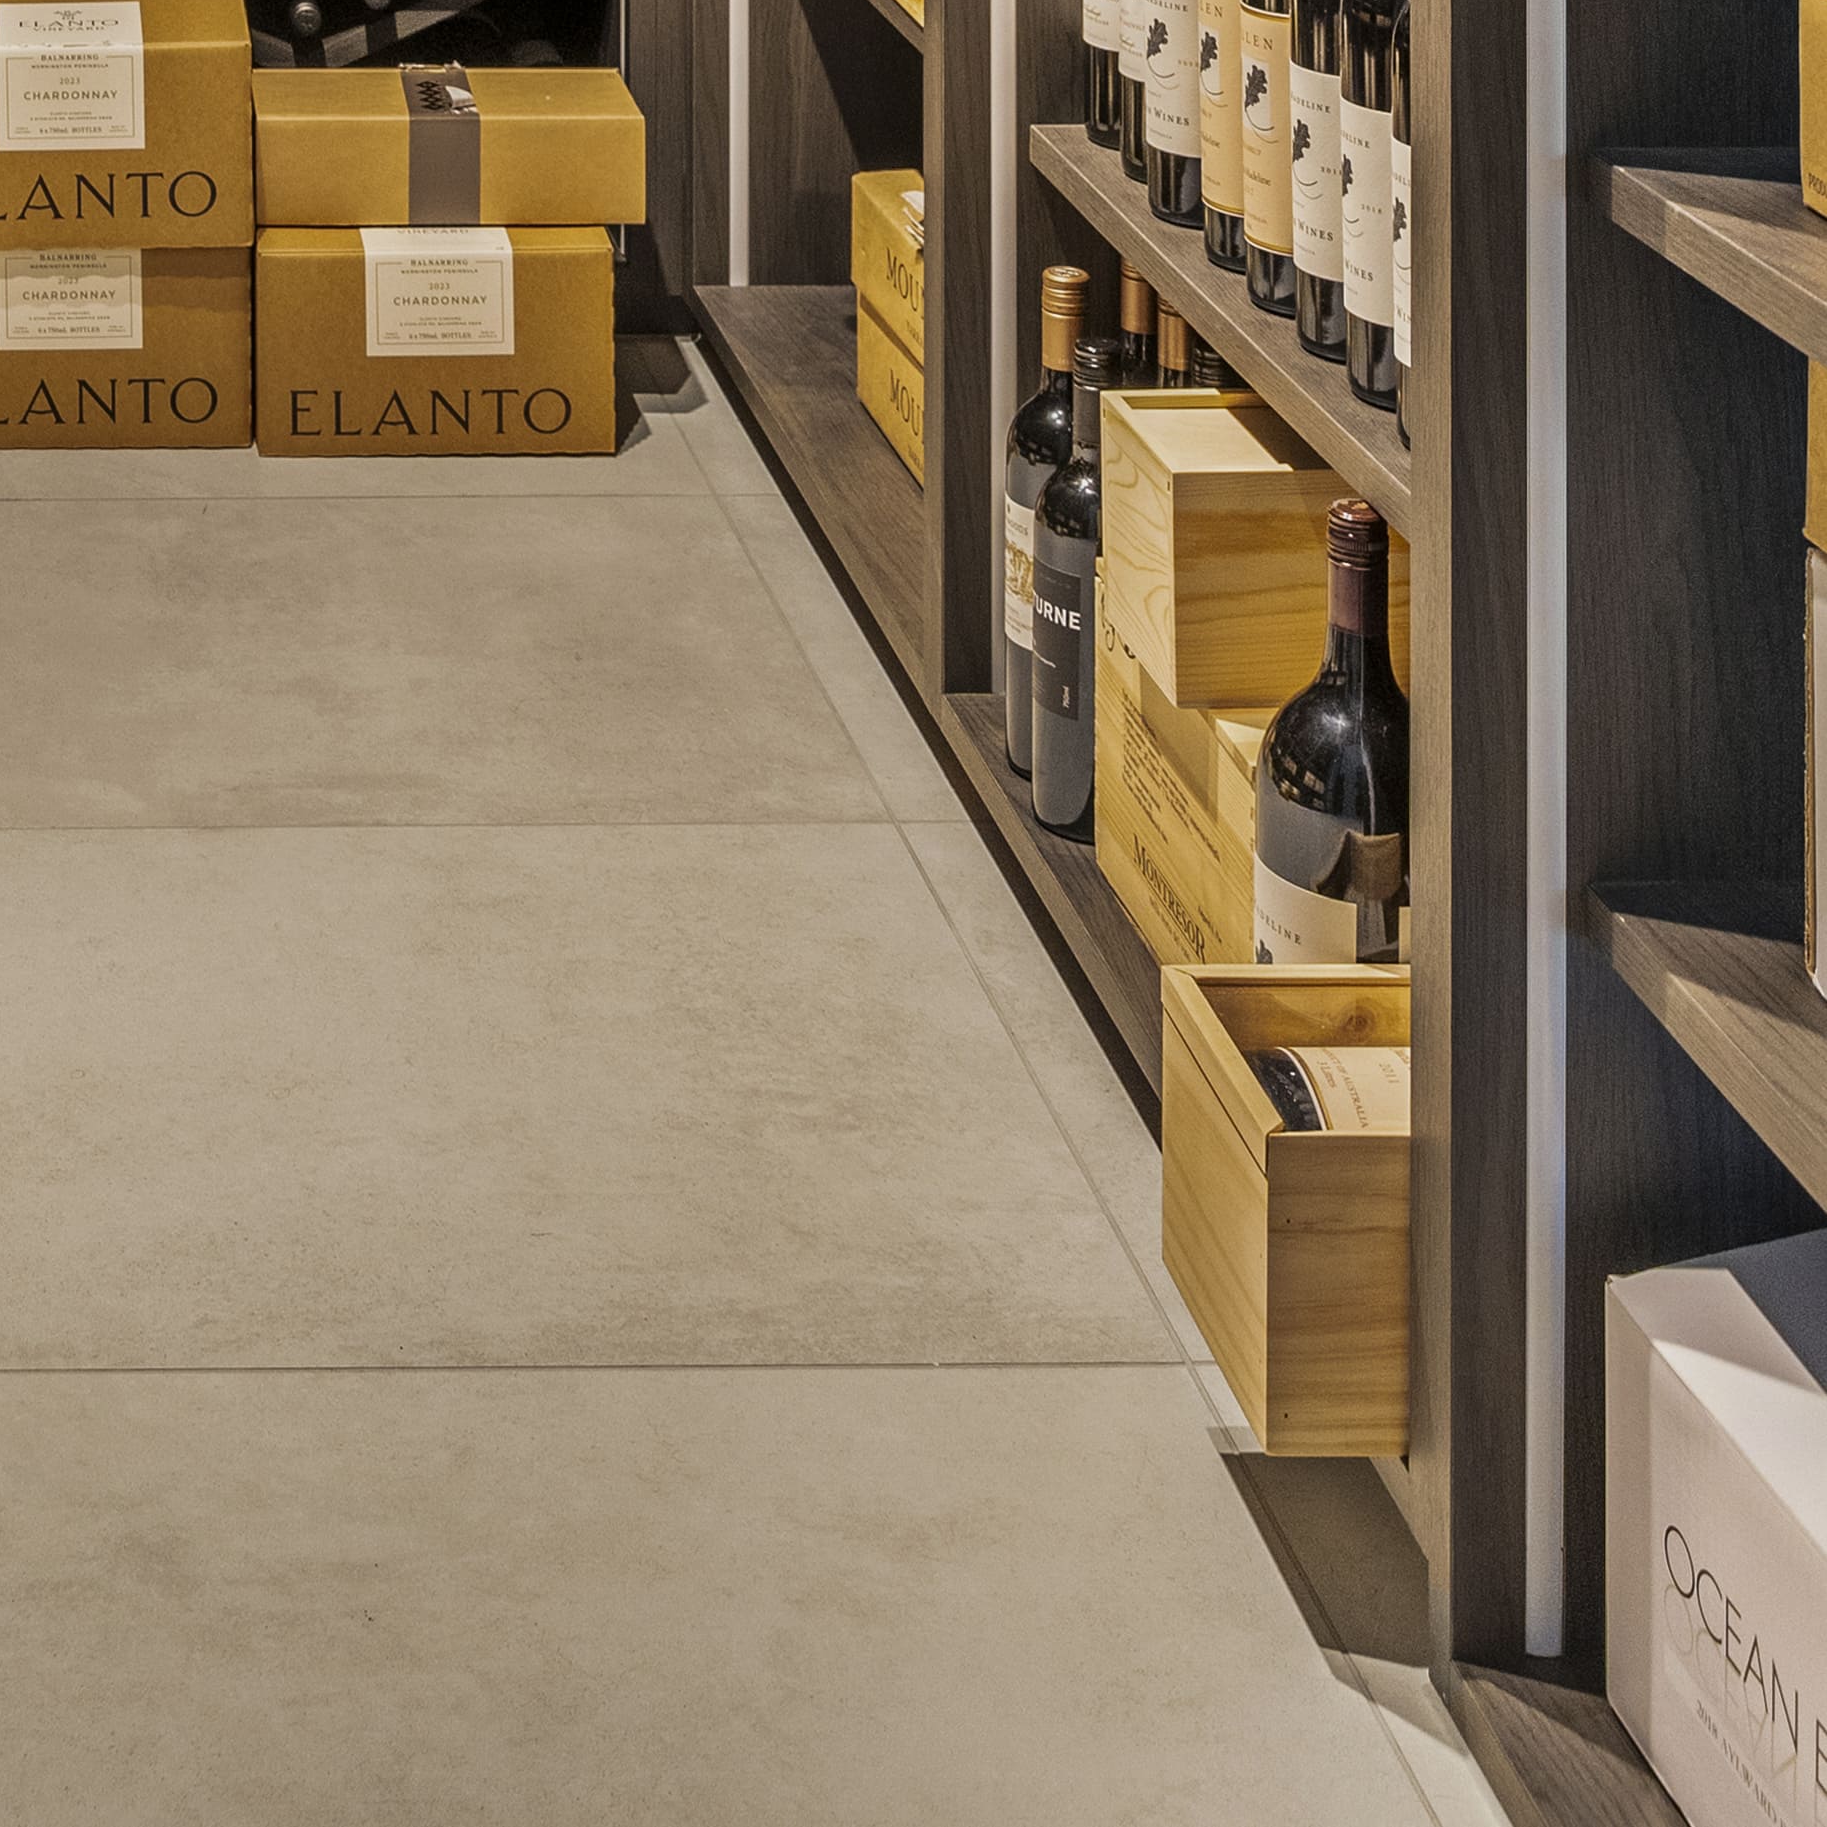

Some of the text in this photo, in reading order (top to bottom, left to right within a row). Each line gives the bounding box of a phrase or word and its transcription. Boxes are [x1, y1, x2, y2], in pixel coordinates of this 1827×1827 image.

[19, 20, 119, 28] ELANTO
[40, 54, 99, 62] BALNARRING
[59, 77, 81, 85] 2023
[23, 90, 118, 101] CHARDONNAY
[1153, 107, 1190, 128] WINES
[1298, 218, 1334, 242] WINES
[39, 254, 97, 262] BALNARRING
[410, 259, 469, 267] BALNARRING
[58, 277, 79, 285] 2023
[886, 246, 924, 314] MOU
[429, 282, 451, 291] 2023
[22, 290, 116, 301] CHARDONNAY
[393, 296, 488, 306] CHARDONNAY
[890, 368, 924, 439] MOU
[289, 386, 573, 439] ELANTO
[1133, 832, 1206, 966] MONTRESOR
[1379, 1062, 1400, 1085] 2011
[1342, 1075, 1369, 1129] AUSTRALIA
[1665, 1525, 1799, 1757] OCEAN
